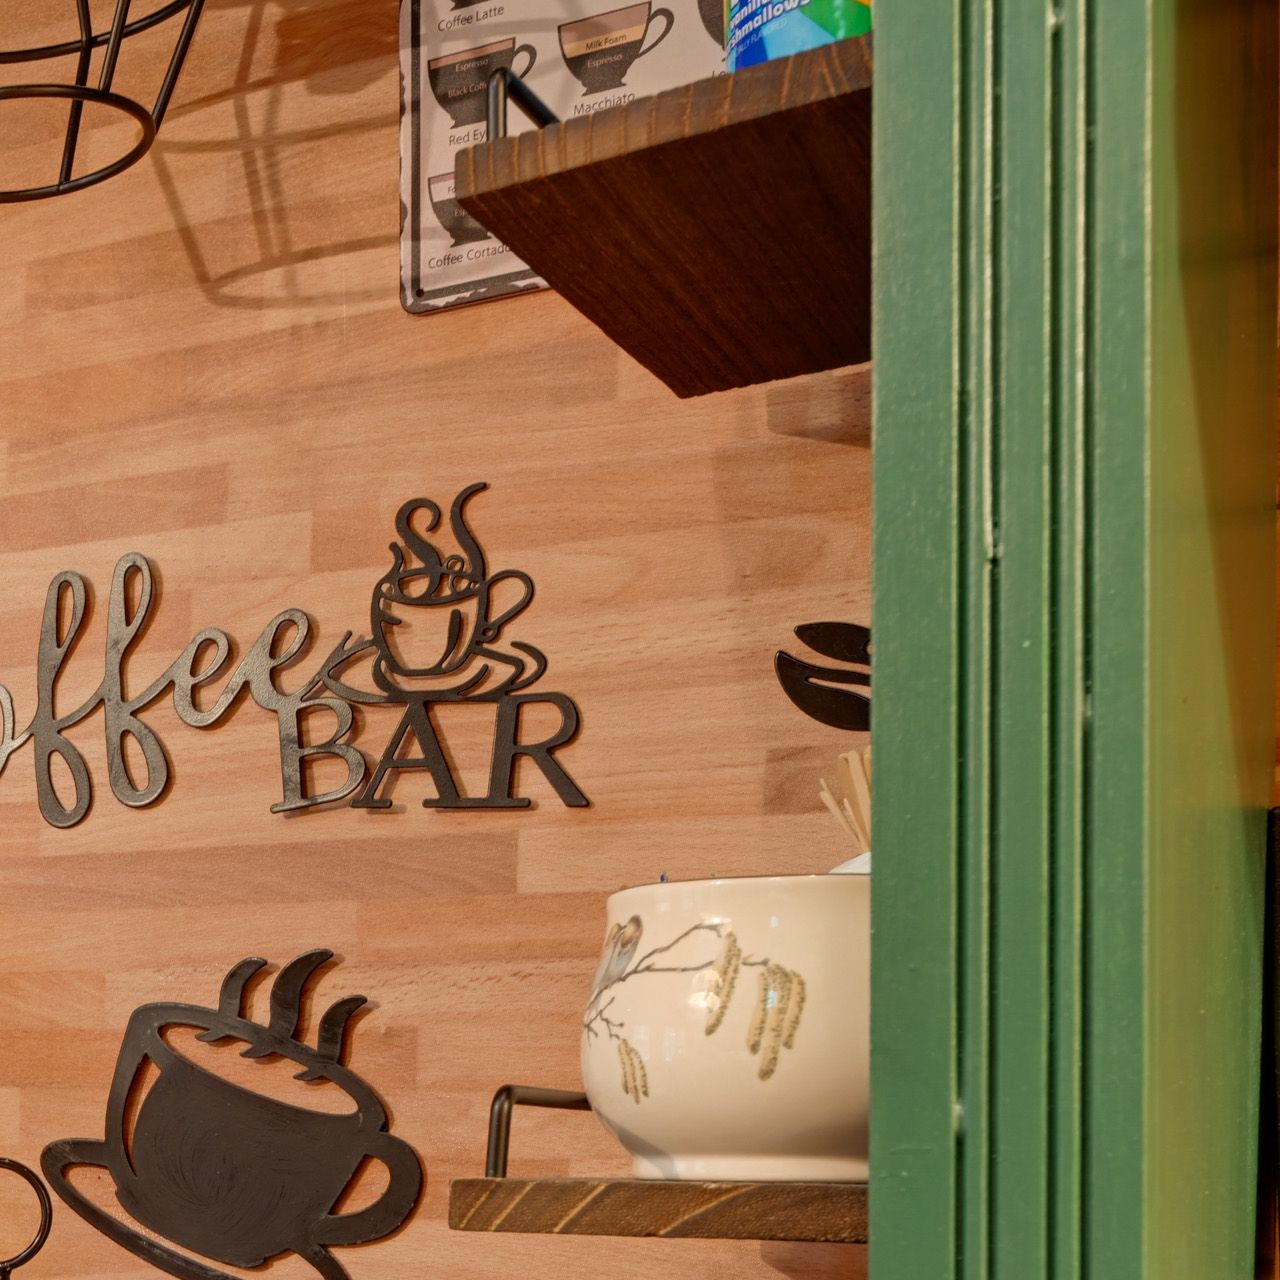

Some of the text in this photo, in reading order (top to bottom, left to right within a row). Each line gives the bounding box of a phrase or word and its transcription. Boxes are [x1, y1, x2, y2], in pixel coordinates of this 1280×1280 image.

[437, 5, 505, 32] Coffee Latte
[585, 33, 628, 51] Milk Foam
[455, 58, 489, 72] Espresso
[587, 54, 623, 69] Espresso
[448, 80, 487, 98] Black Coff
[573, 93, 637, 115] Macchiato
[449, 128, 486, 147] Red Ey
[428, 253, 463, 269] Coffee
[271, 690, 591, 814] BAR
